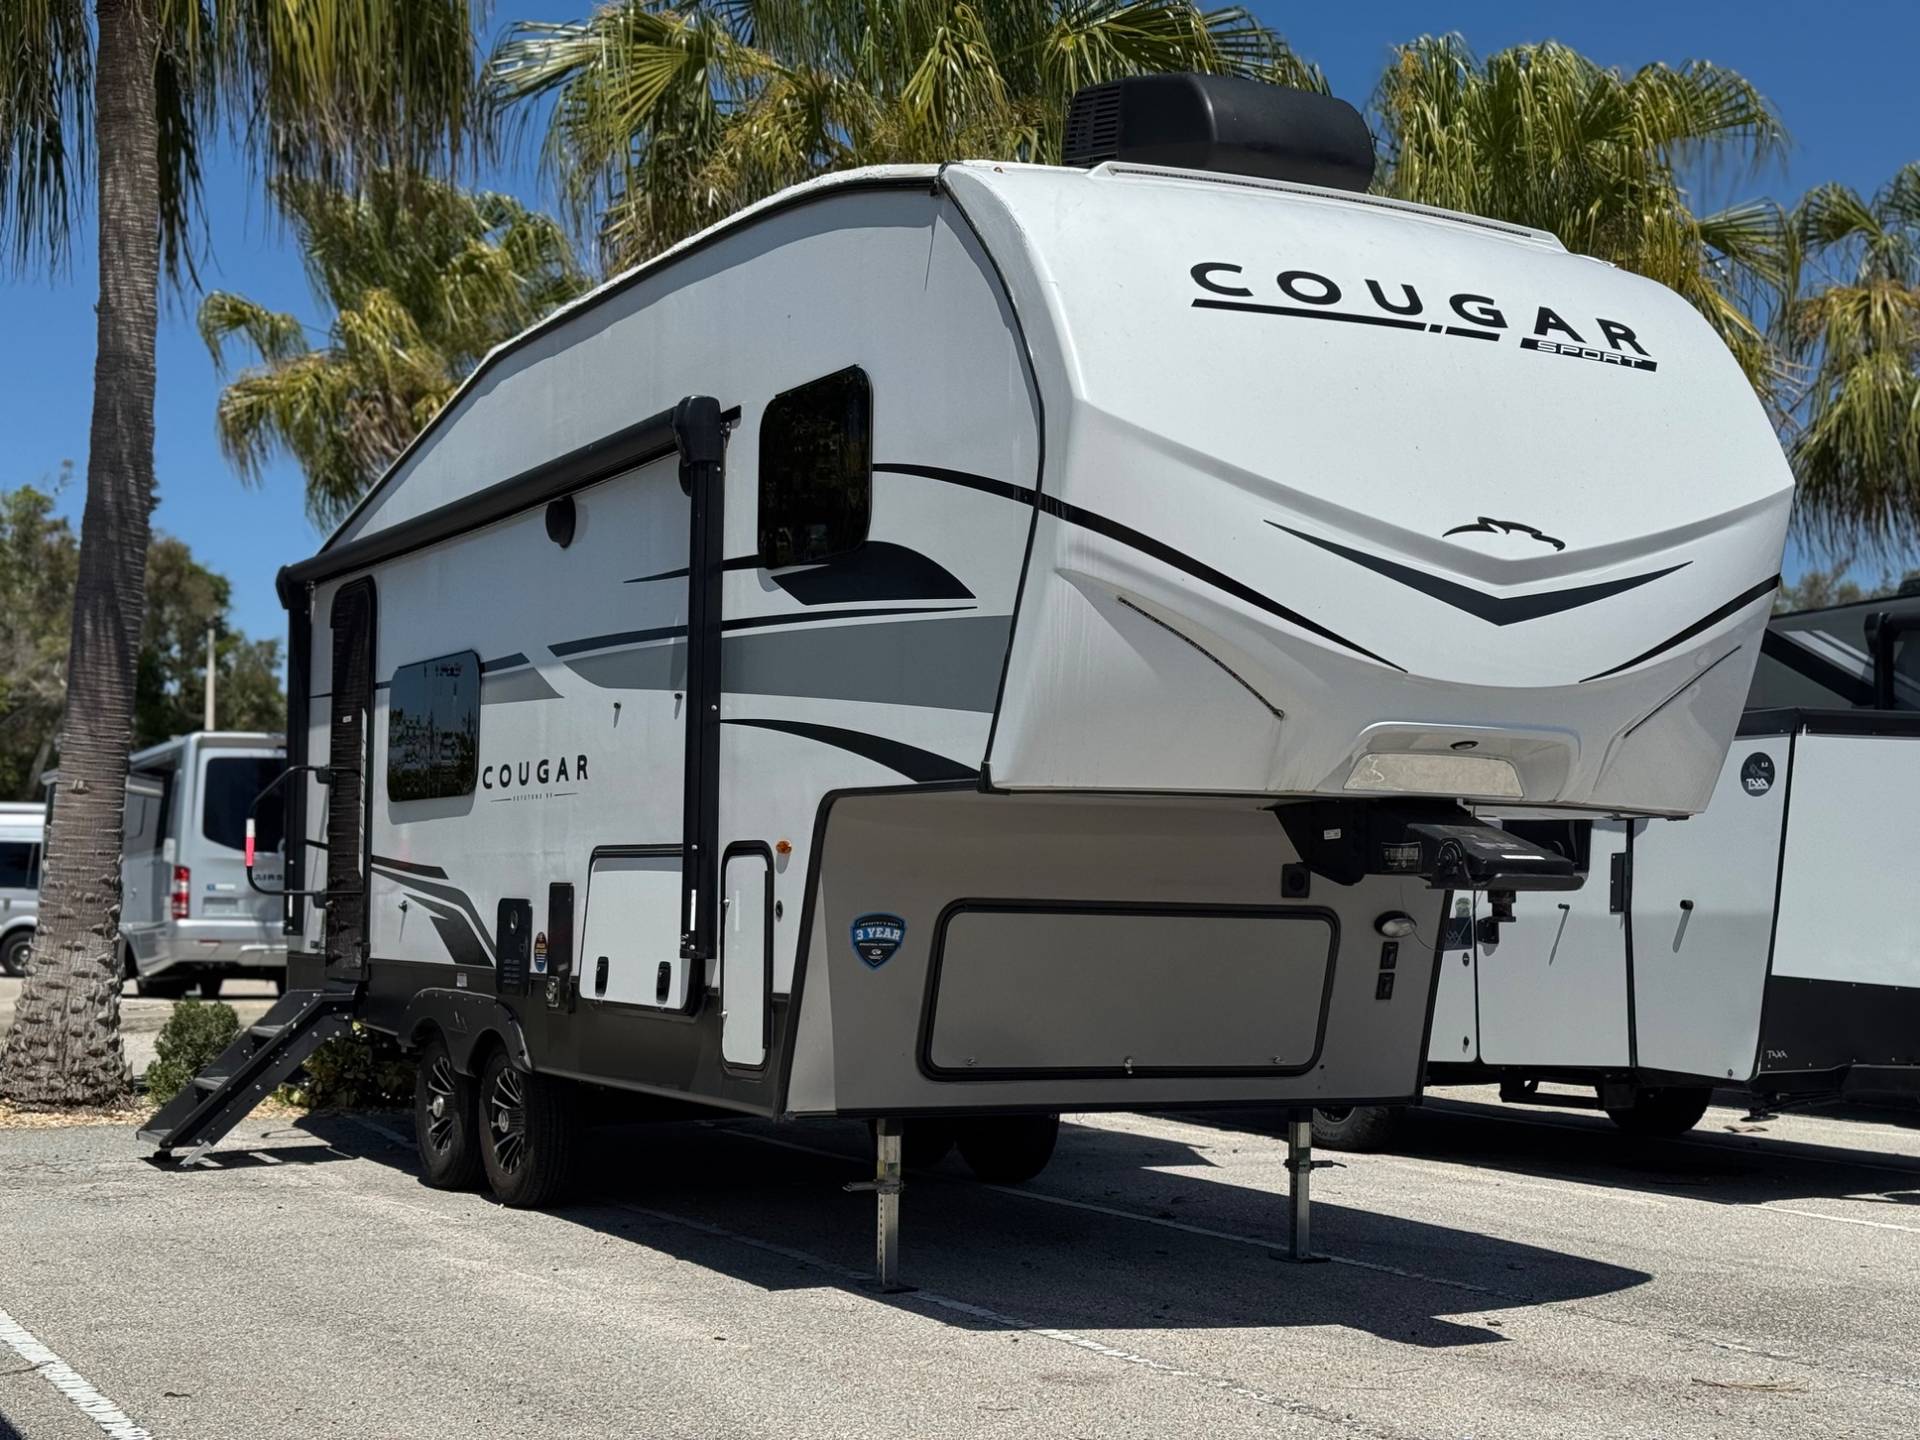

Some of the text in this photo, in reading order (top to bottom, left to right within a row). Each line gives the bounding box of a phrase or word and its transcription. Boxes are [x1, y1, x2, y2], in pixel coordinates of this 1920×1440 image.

[1190, 261, 1652, 357] COUGAR
[1536, 340, 1643, 369] SPORT
[482, 754, 589, 790] COUGAR
[856, 927, 901, 941] 3 YEAR
